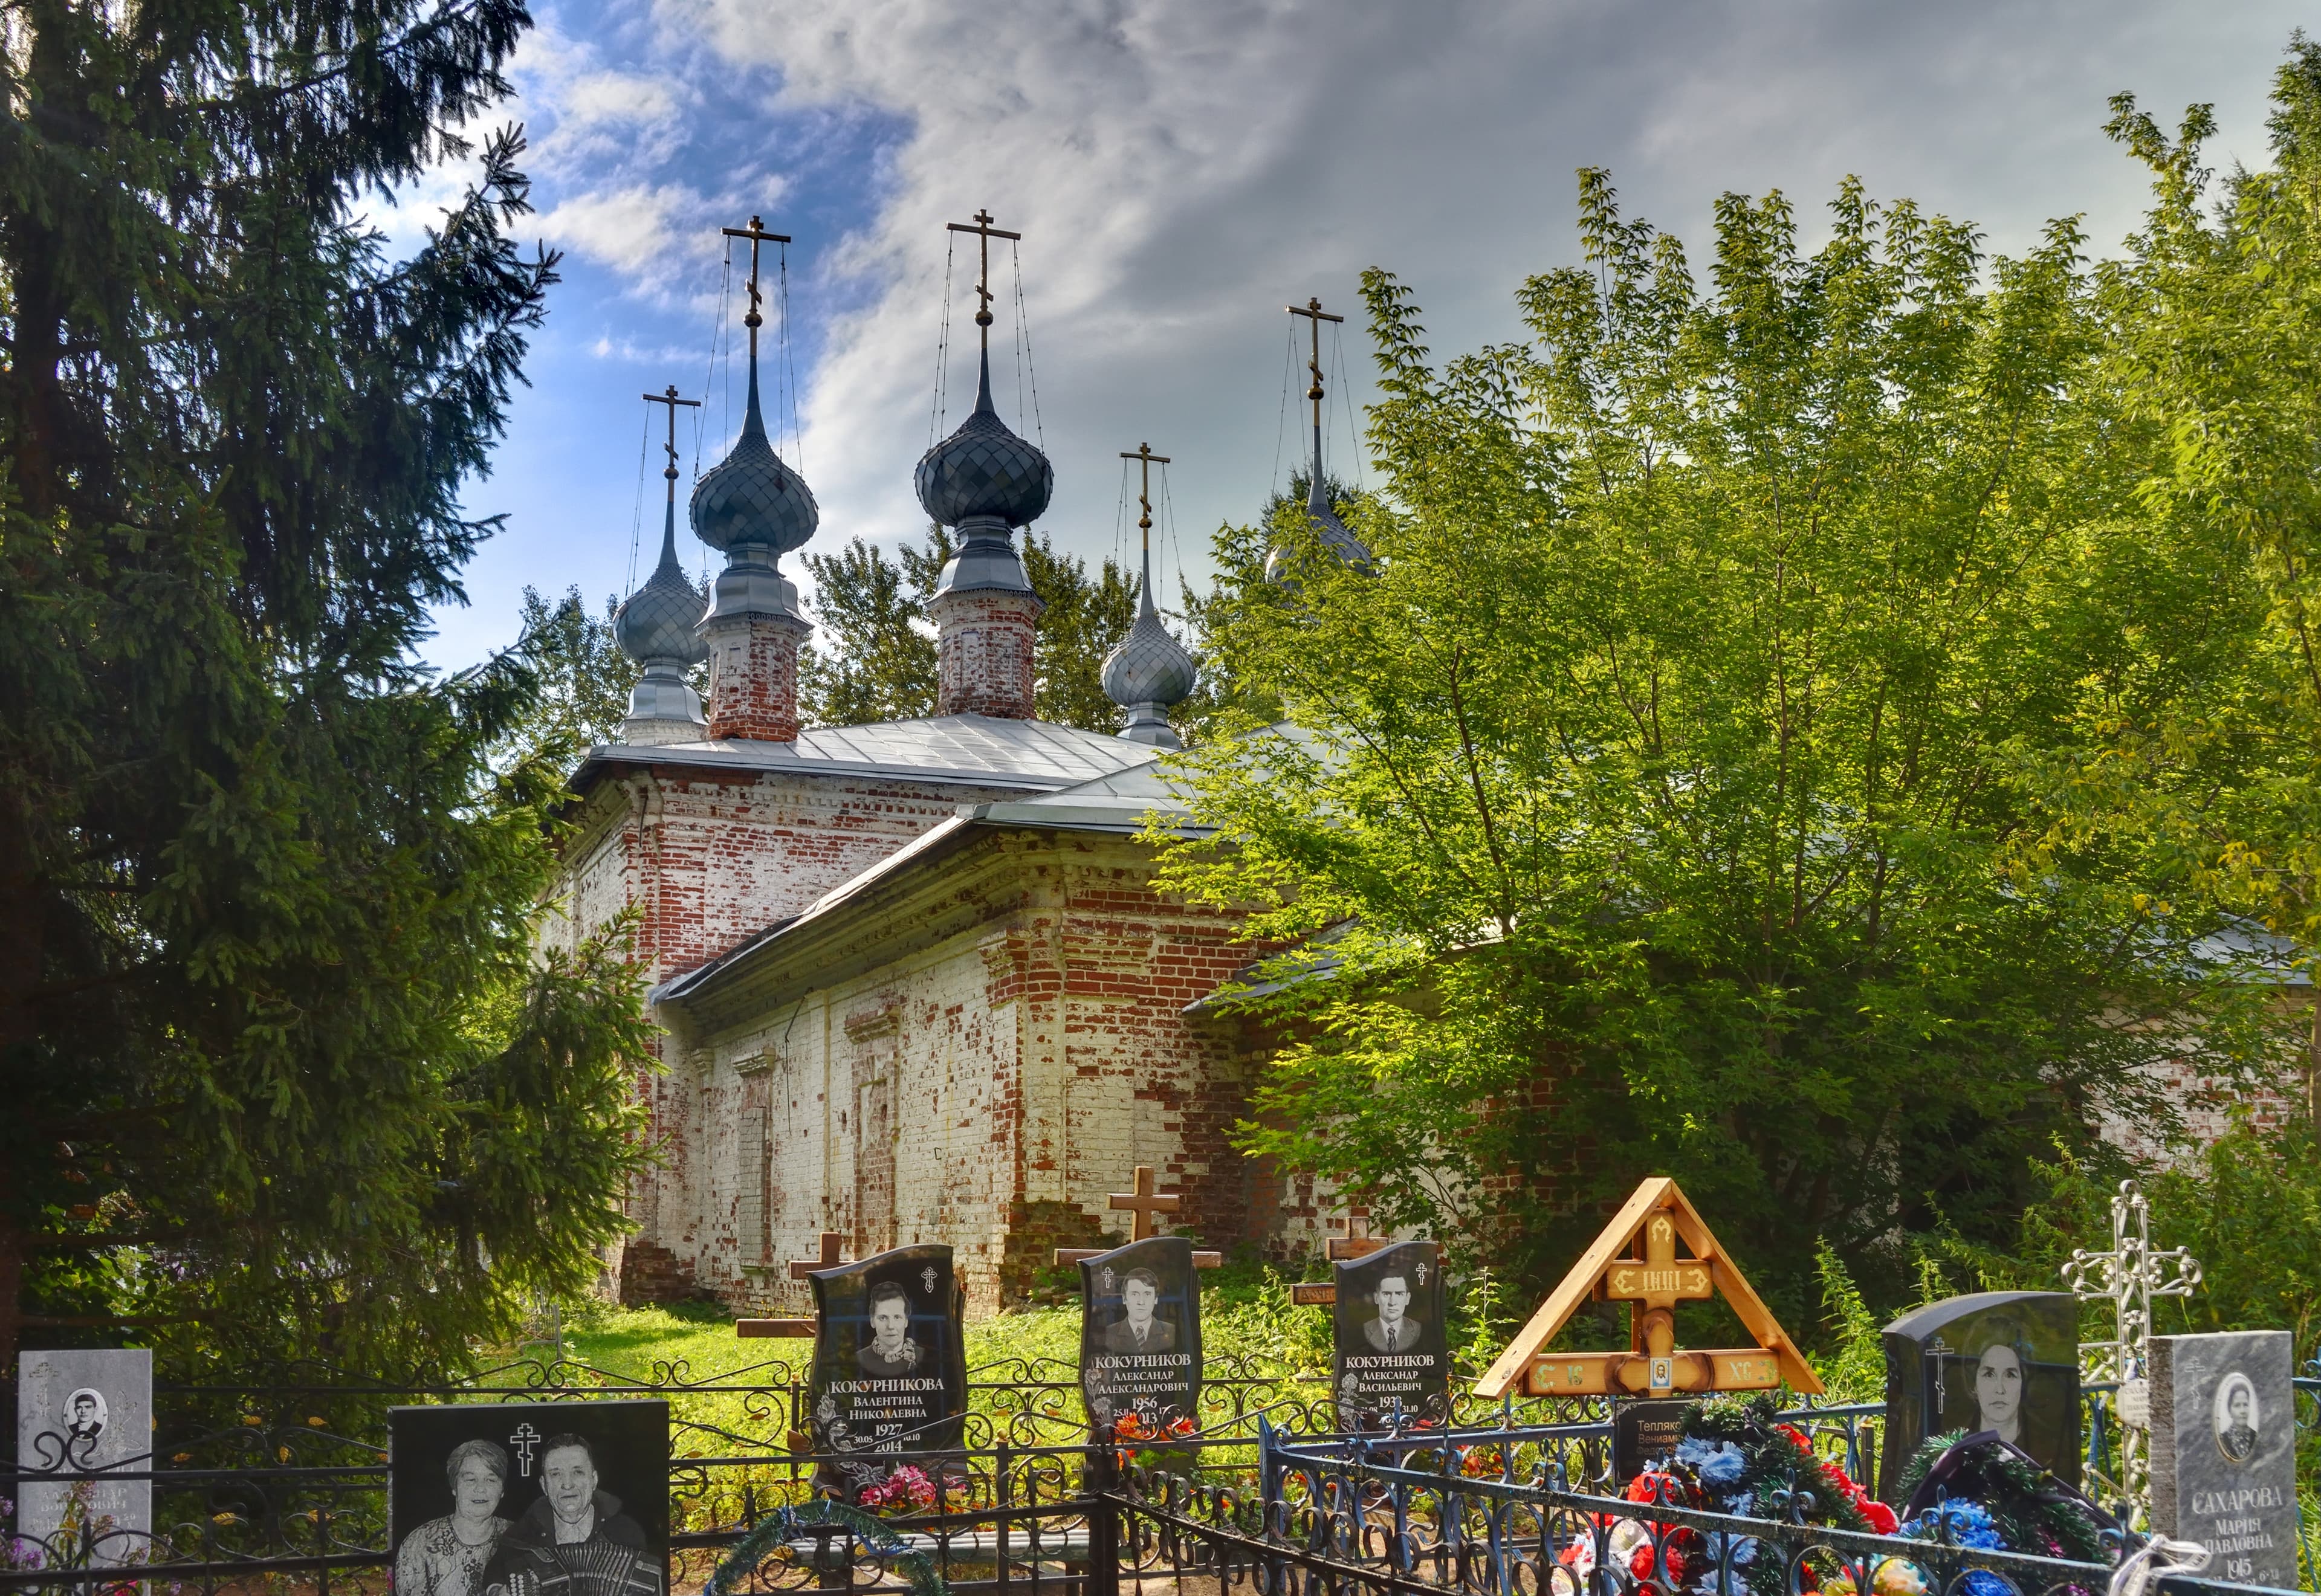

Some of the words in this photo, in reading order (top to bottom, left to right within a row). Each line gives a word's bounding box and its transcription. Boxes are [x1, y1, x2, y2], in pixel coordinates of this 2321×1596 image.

[1095, 1354, 1191, 1369] КОКУРНИКОВ
[1345, 1355, 1434, 1369] КОКУРНИКОВ
[1112, 1371, 1174, 1382] АЛЕКСАНДР
[1362, 1370, 1419, 1381] АЛЕКСАНДР
[830, 1378, 945, 1394] КОКУРНИКОВА
[1098, 1383, 1189, 1394] АЛЕКСАНДРОВИЧ
[1359, 1383, 1422, 1392] ВАСИЛЬЕВИЧ
[853, 1396, 923, 1407] ВАЛЕНТИНА
[1132, 1396, 1158, 1409] 1956
[849, 1409, 928, 1420] НИКОЛАЕВНА
[875, 1424, 903, 1436] 1927
[1637, 1420, 1682, 1432] Тепляко
[874, 1440, 903, 1453] 2014
[2192, 1485, 2284, 1514] САХАРОВА
[2215, 1517, 2261, 1537] МАРИЯ
[2204, 1533, 2273, 1555] ПАВЛОВНА
[2227, 1558, 2253, 1580] 1915
